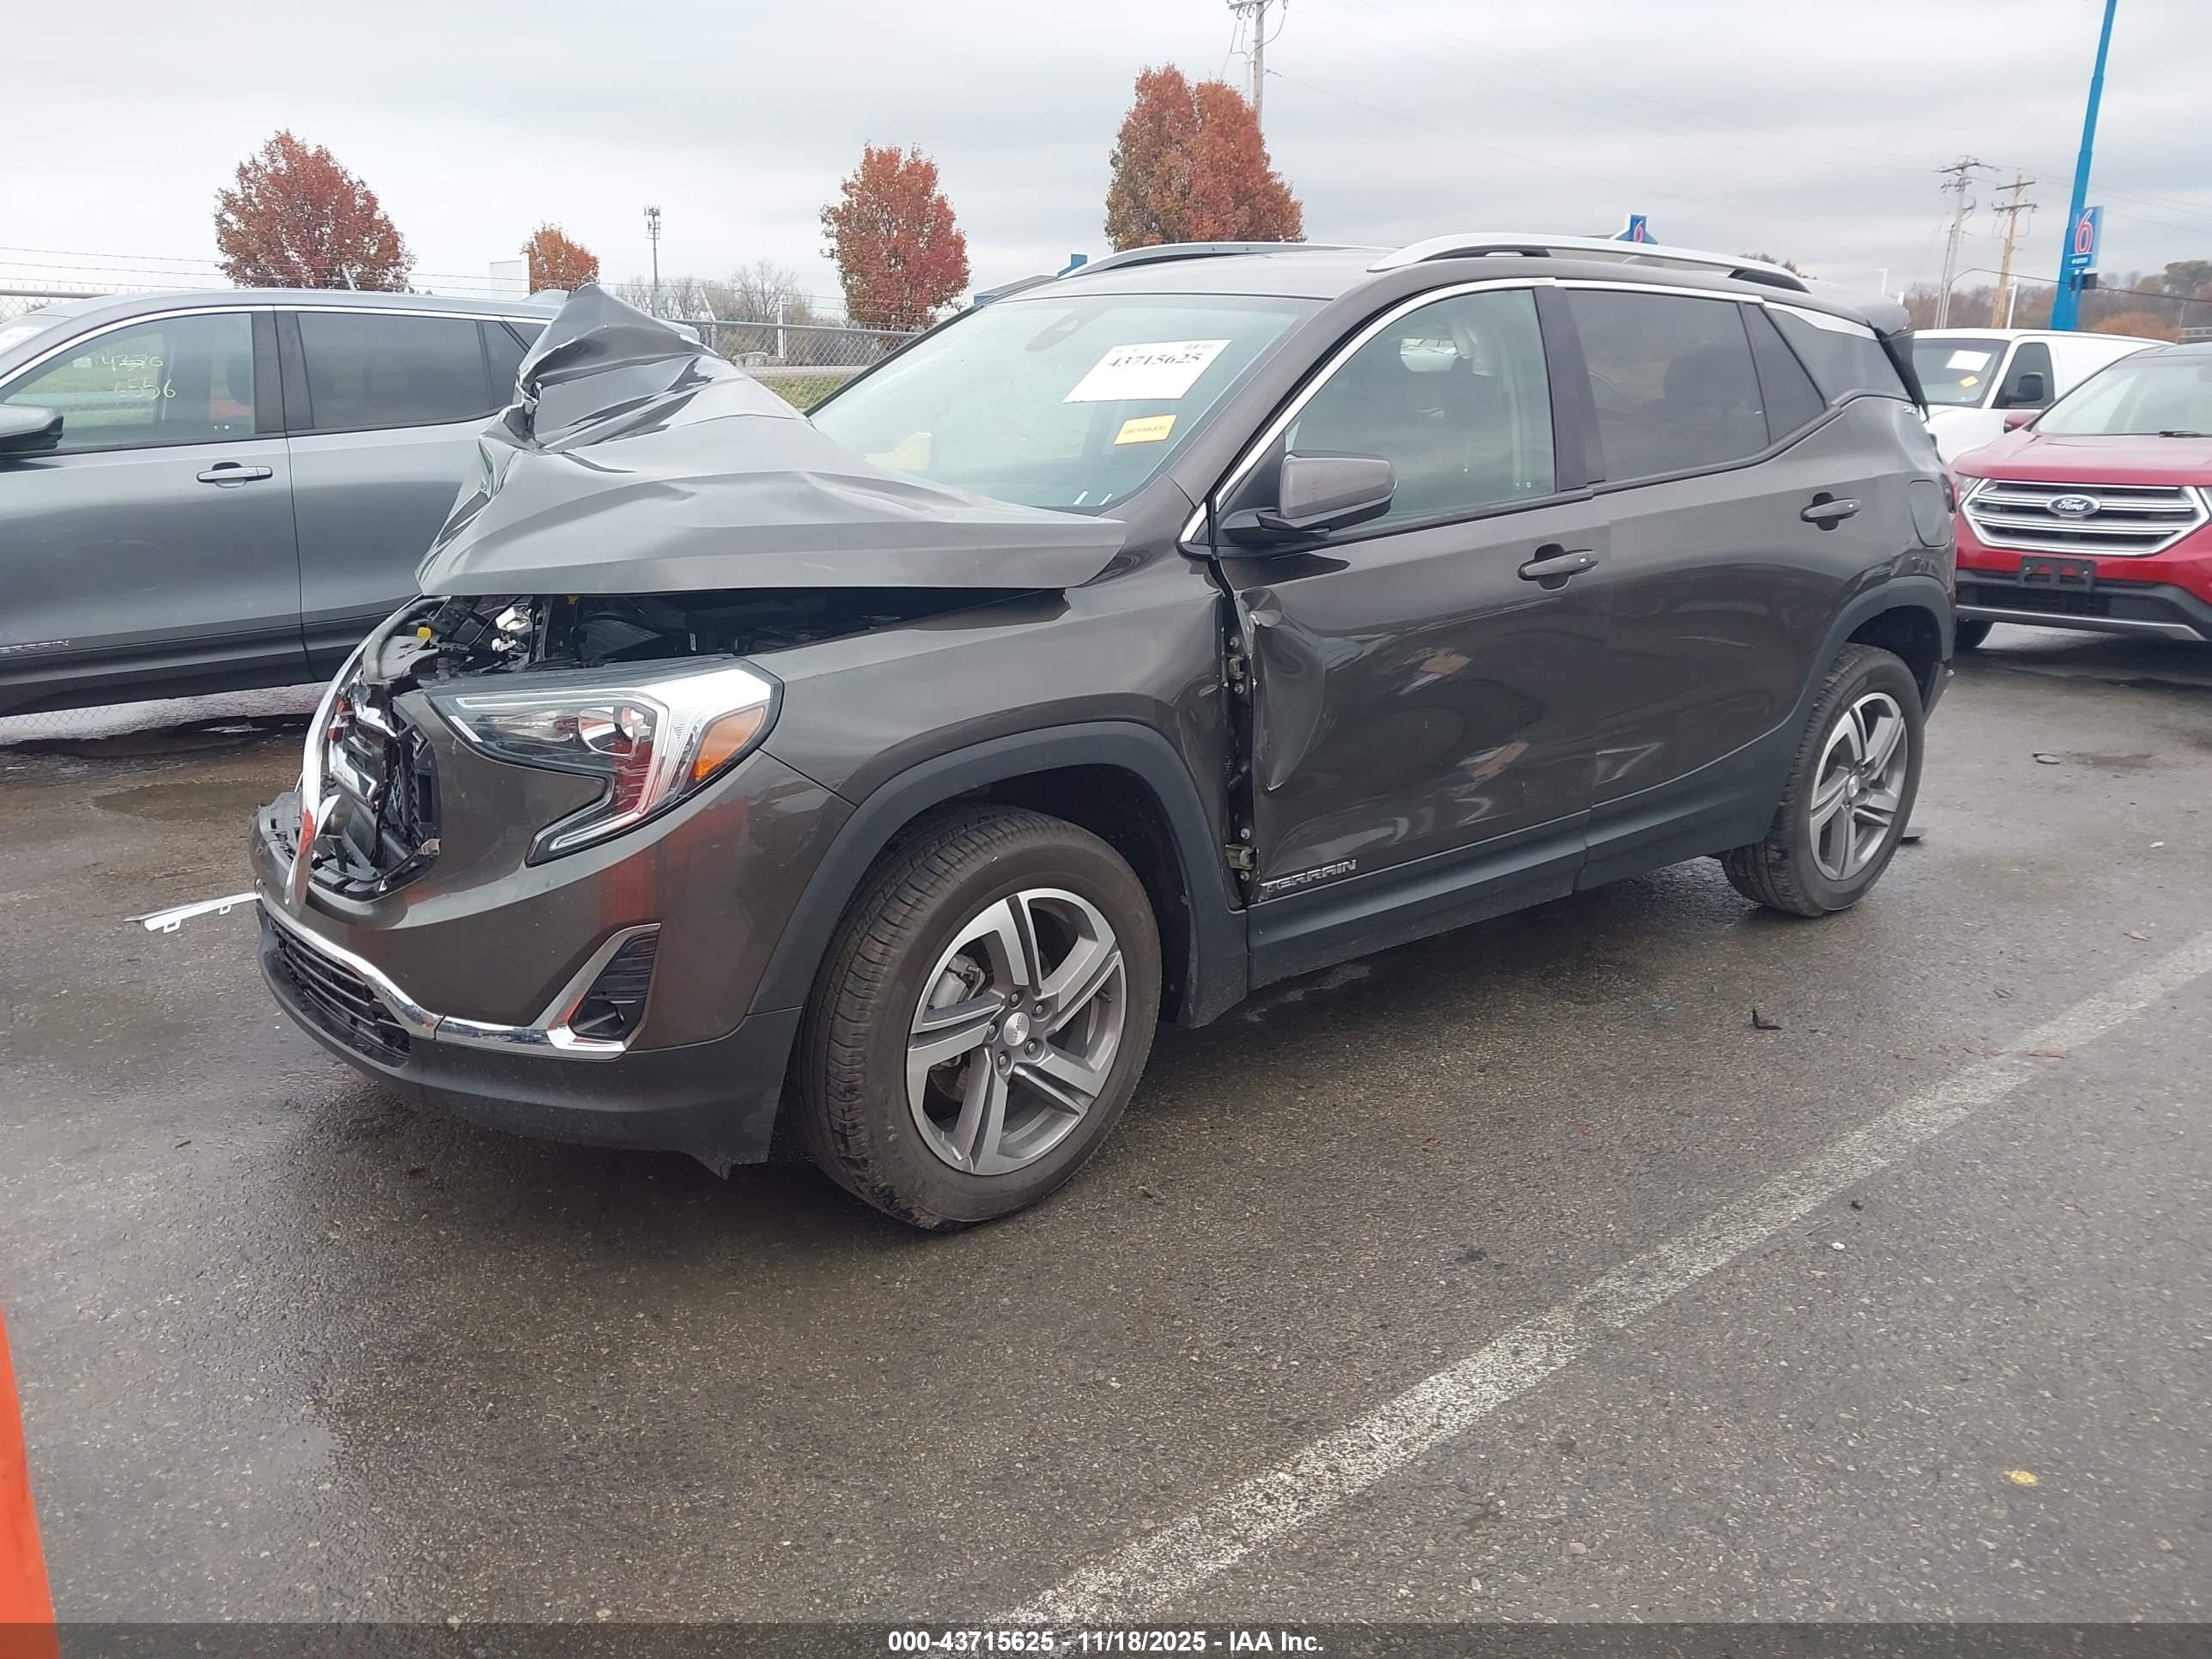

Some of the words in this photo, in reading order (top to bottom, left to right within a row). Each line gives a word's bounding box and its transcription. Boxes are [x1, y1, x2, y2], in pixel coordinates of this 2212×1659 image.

[2075, 209, 2094, 254] 6
[1107, 353, 1203, 368] 43715625
[2057, 498, 2087, 511] Ford
[1260, 860, 1358, 894] TERRAIN
